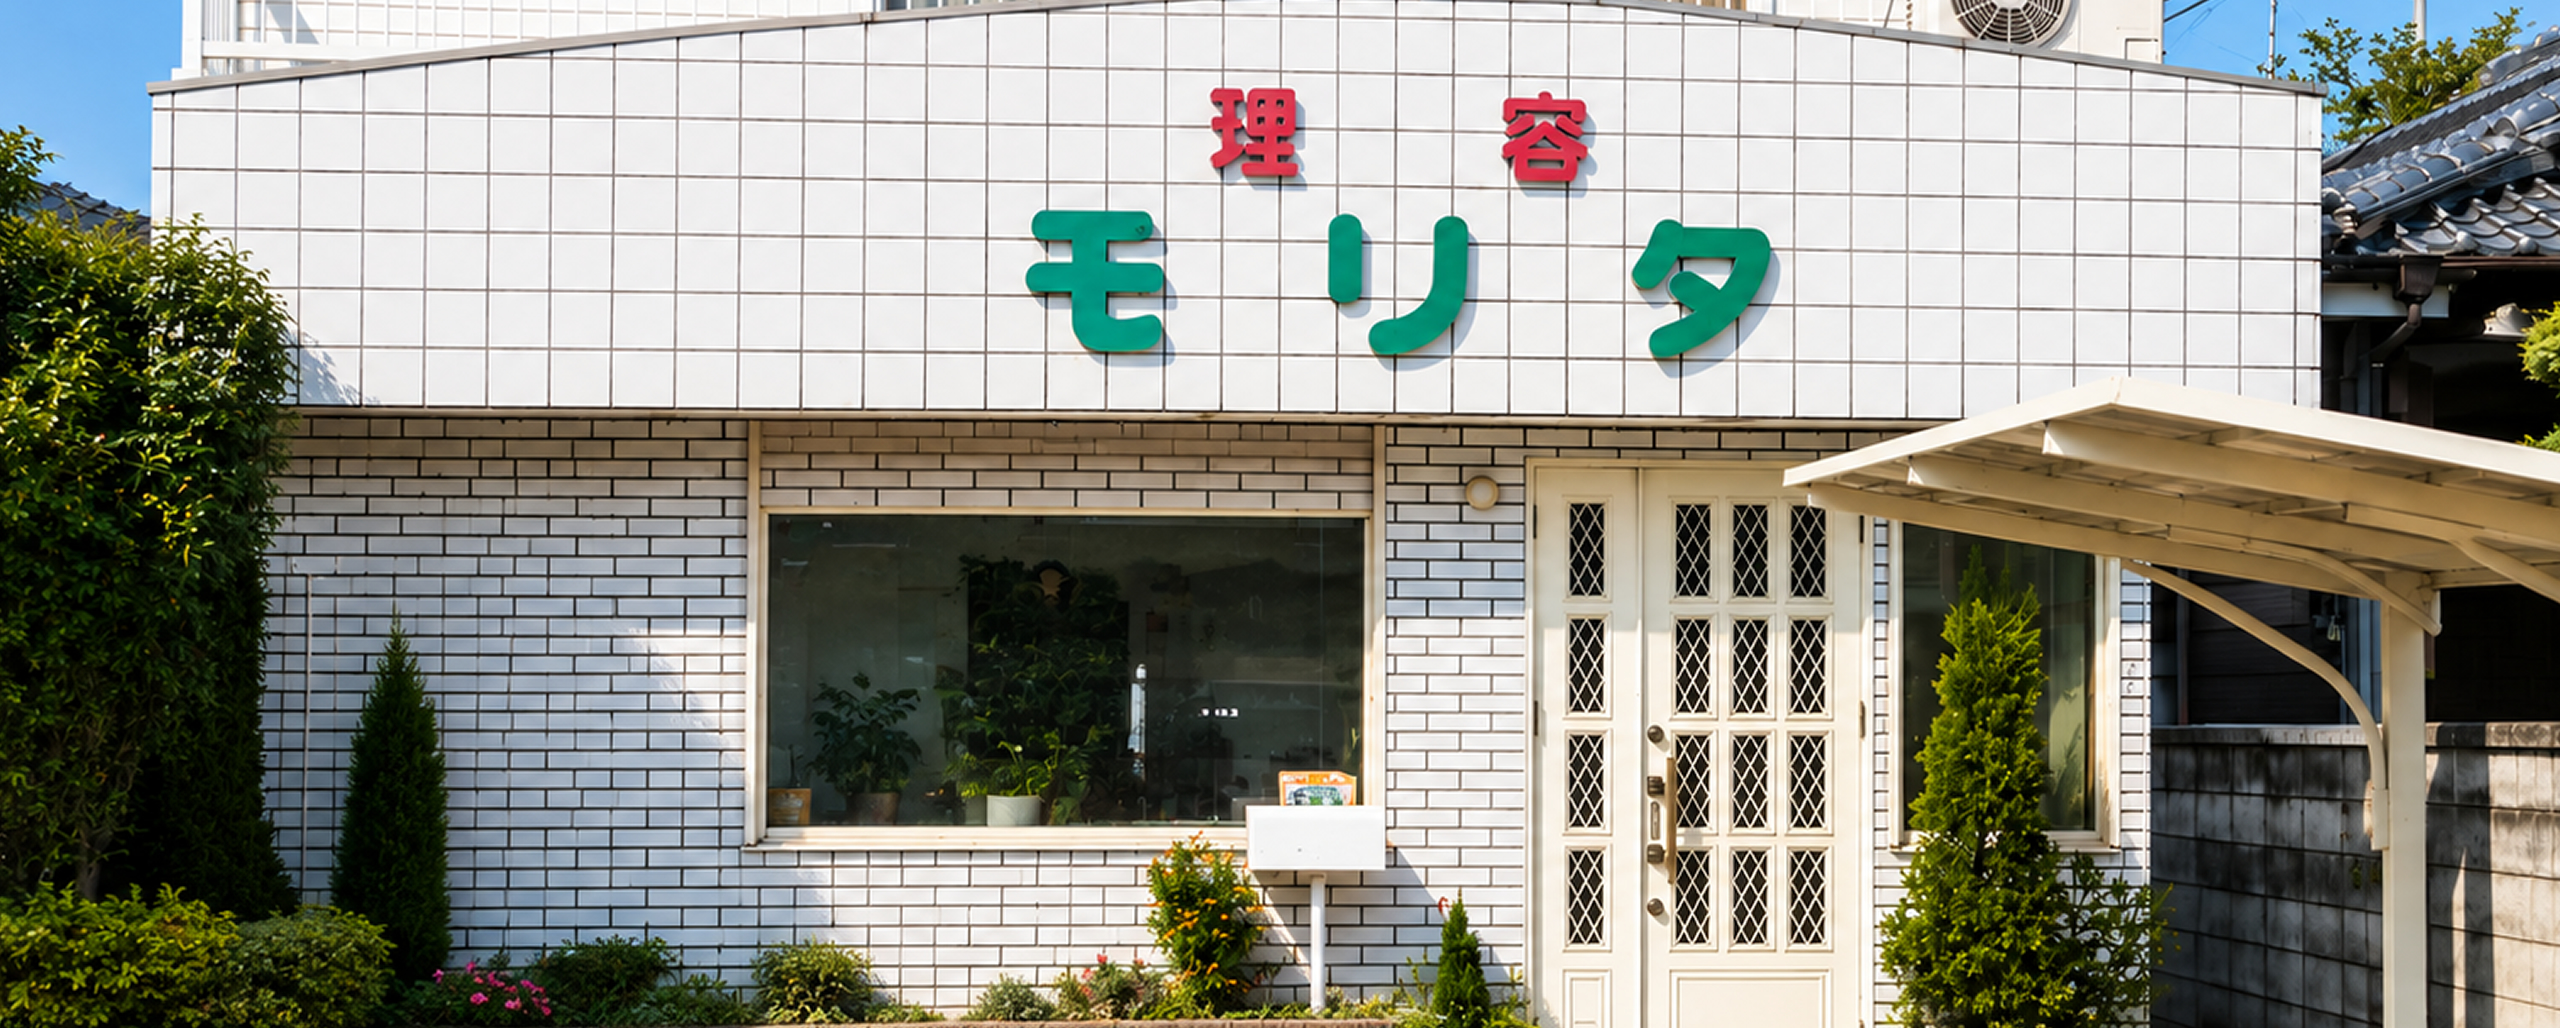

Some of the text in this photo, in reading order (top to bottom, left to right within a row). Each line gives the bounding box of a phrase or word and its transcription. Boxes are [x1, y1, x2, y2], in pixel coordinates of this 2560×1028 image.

[1211, 87, 1588, 183] 理容
[1026, 209, 1772, 358] モリタ
